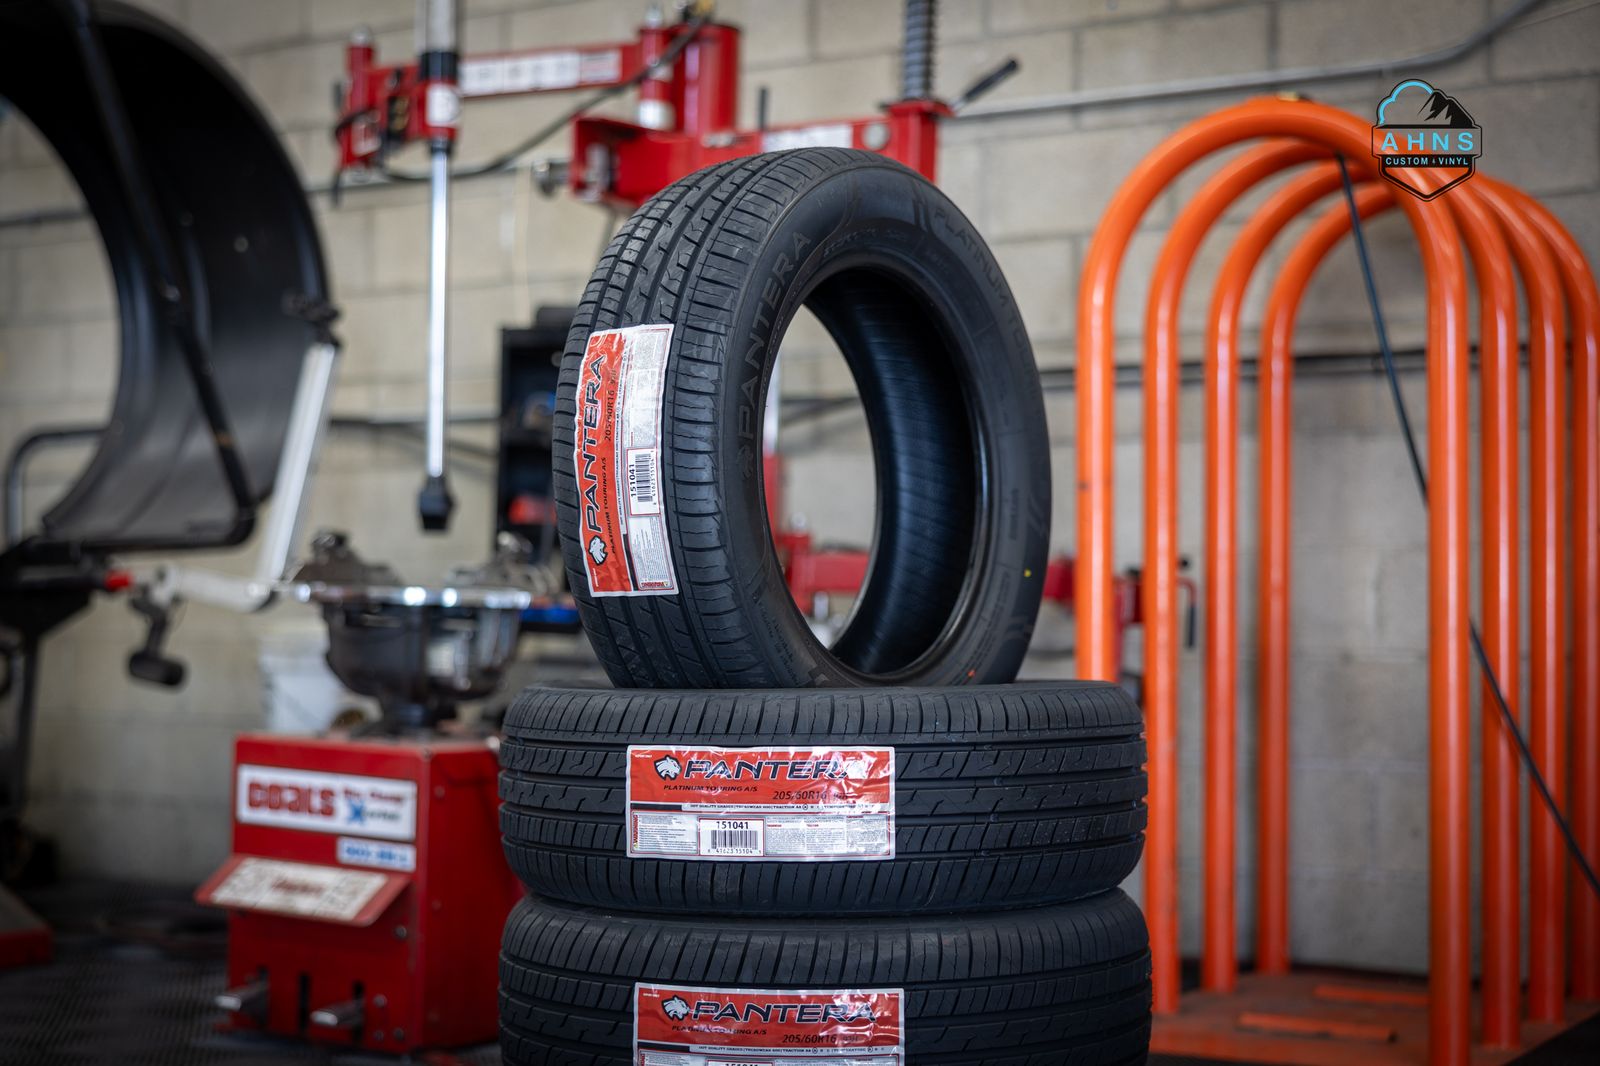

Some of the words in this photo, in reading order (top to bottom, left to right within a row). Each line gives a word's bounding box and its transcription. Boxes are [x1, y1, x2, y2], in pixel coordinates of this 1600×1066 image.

[934, 207, 1011, 308] PLATINUM
[737, 231, 812, 439] PANTERA
[604, 390, 615, 442] 205/60R16
[582, 354, 606, 534] PANTERA
[601, 472, 610, 510] TOURING
[629, 464, 637, 498] 151041
[605, 512, 616, 554] PLATINUM
[684, 760, 856, 780] PANTER
[772, 790, 827, 801] 205/60R16
[716, 821, 749, 830] 151041
[691, 1000, 877, 1023] PANTERA
[782, 1034, 837, 1044] 205/60R16
